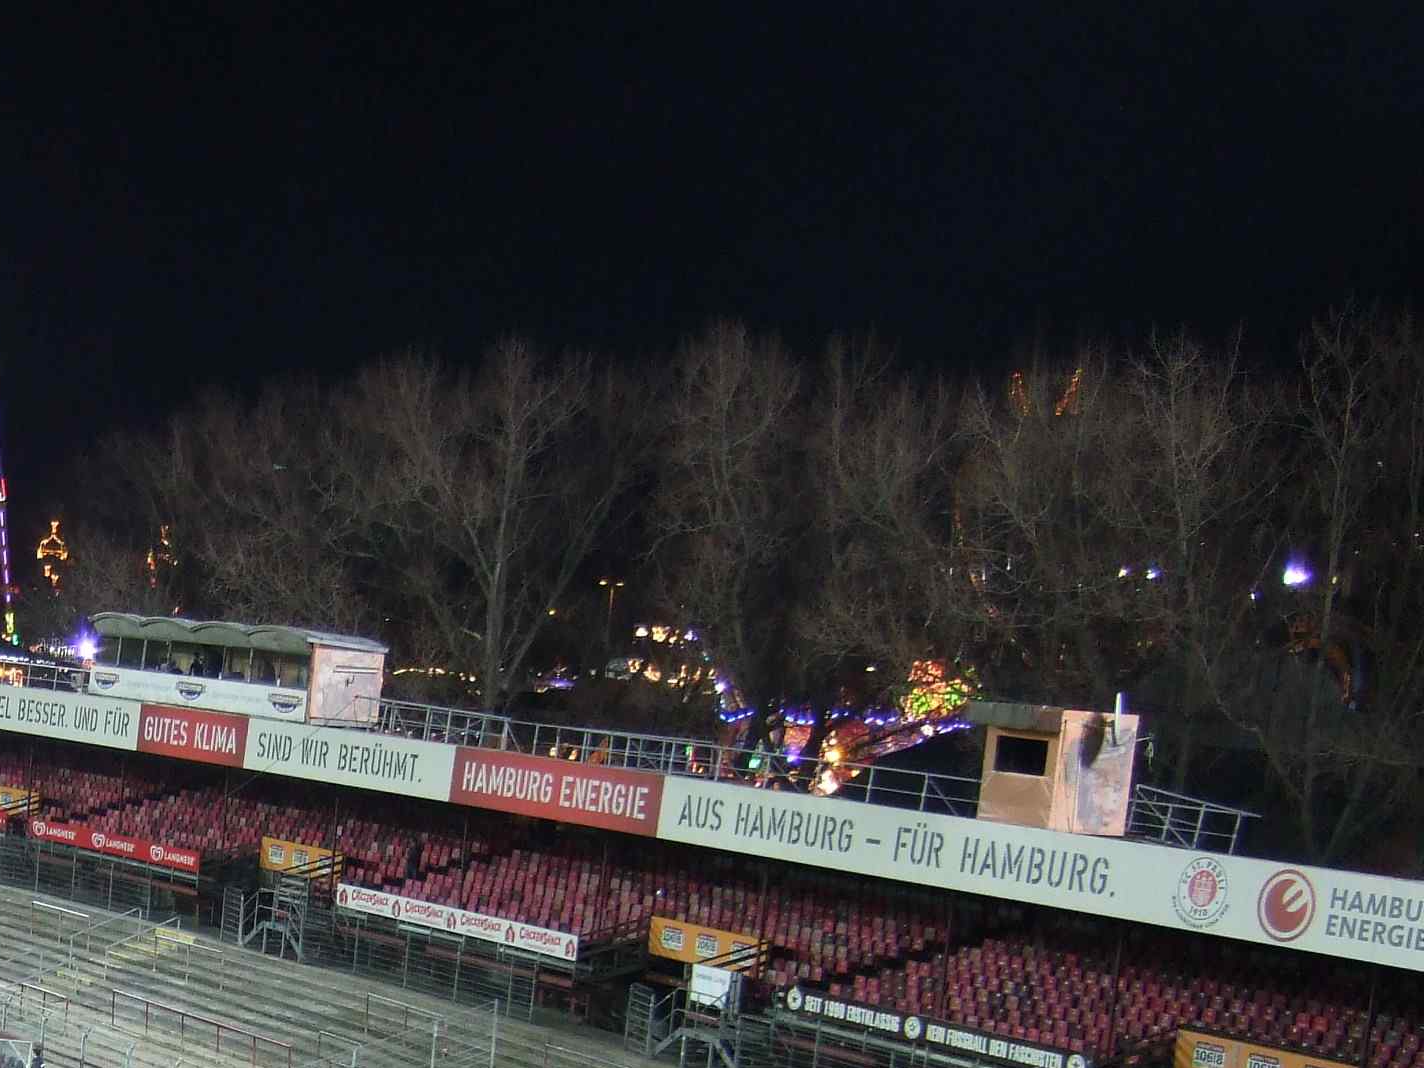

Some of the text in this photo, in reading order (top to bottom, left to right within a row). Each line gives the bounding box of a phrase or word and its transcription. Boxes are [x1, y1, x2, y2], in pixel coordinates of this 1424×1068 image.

[17, 699, 68, 728] BESSER.
[74, 706, 98, 732] UND
[104, 708, 130, 737] FÜR
[144, 716, 236, 754] GUTES KLIMA
[256, 732, 422, 783] SIND WIR BERÜHMT.
[462, 761, 649, 820] HAMBURG ENERGIE
[678, 795, 725, 832] AUS
[734, 803, 854, 854] HAMBURG
[893, 823, 945, 869] FÜR
[960, 836, 1115, 898] HAMBURG.
